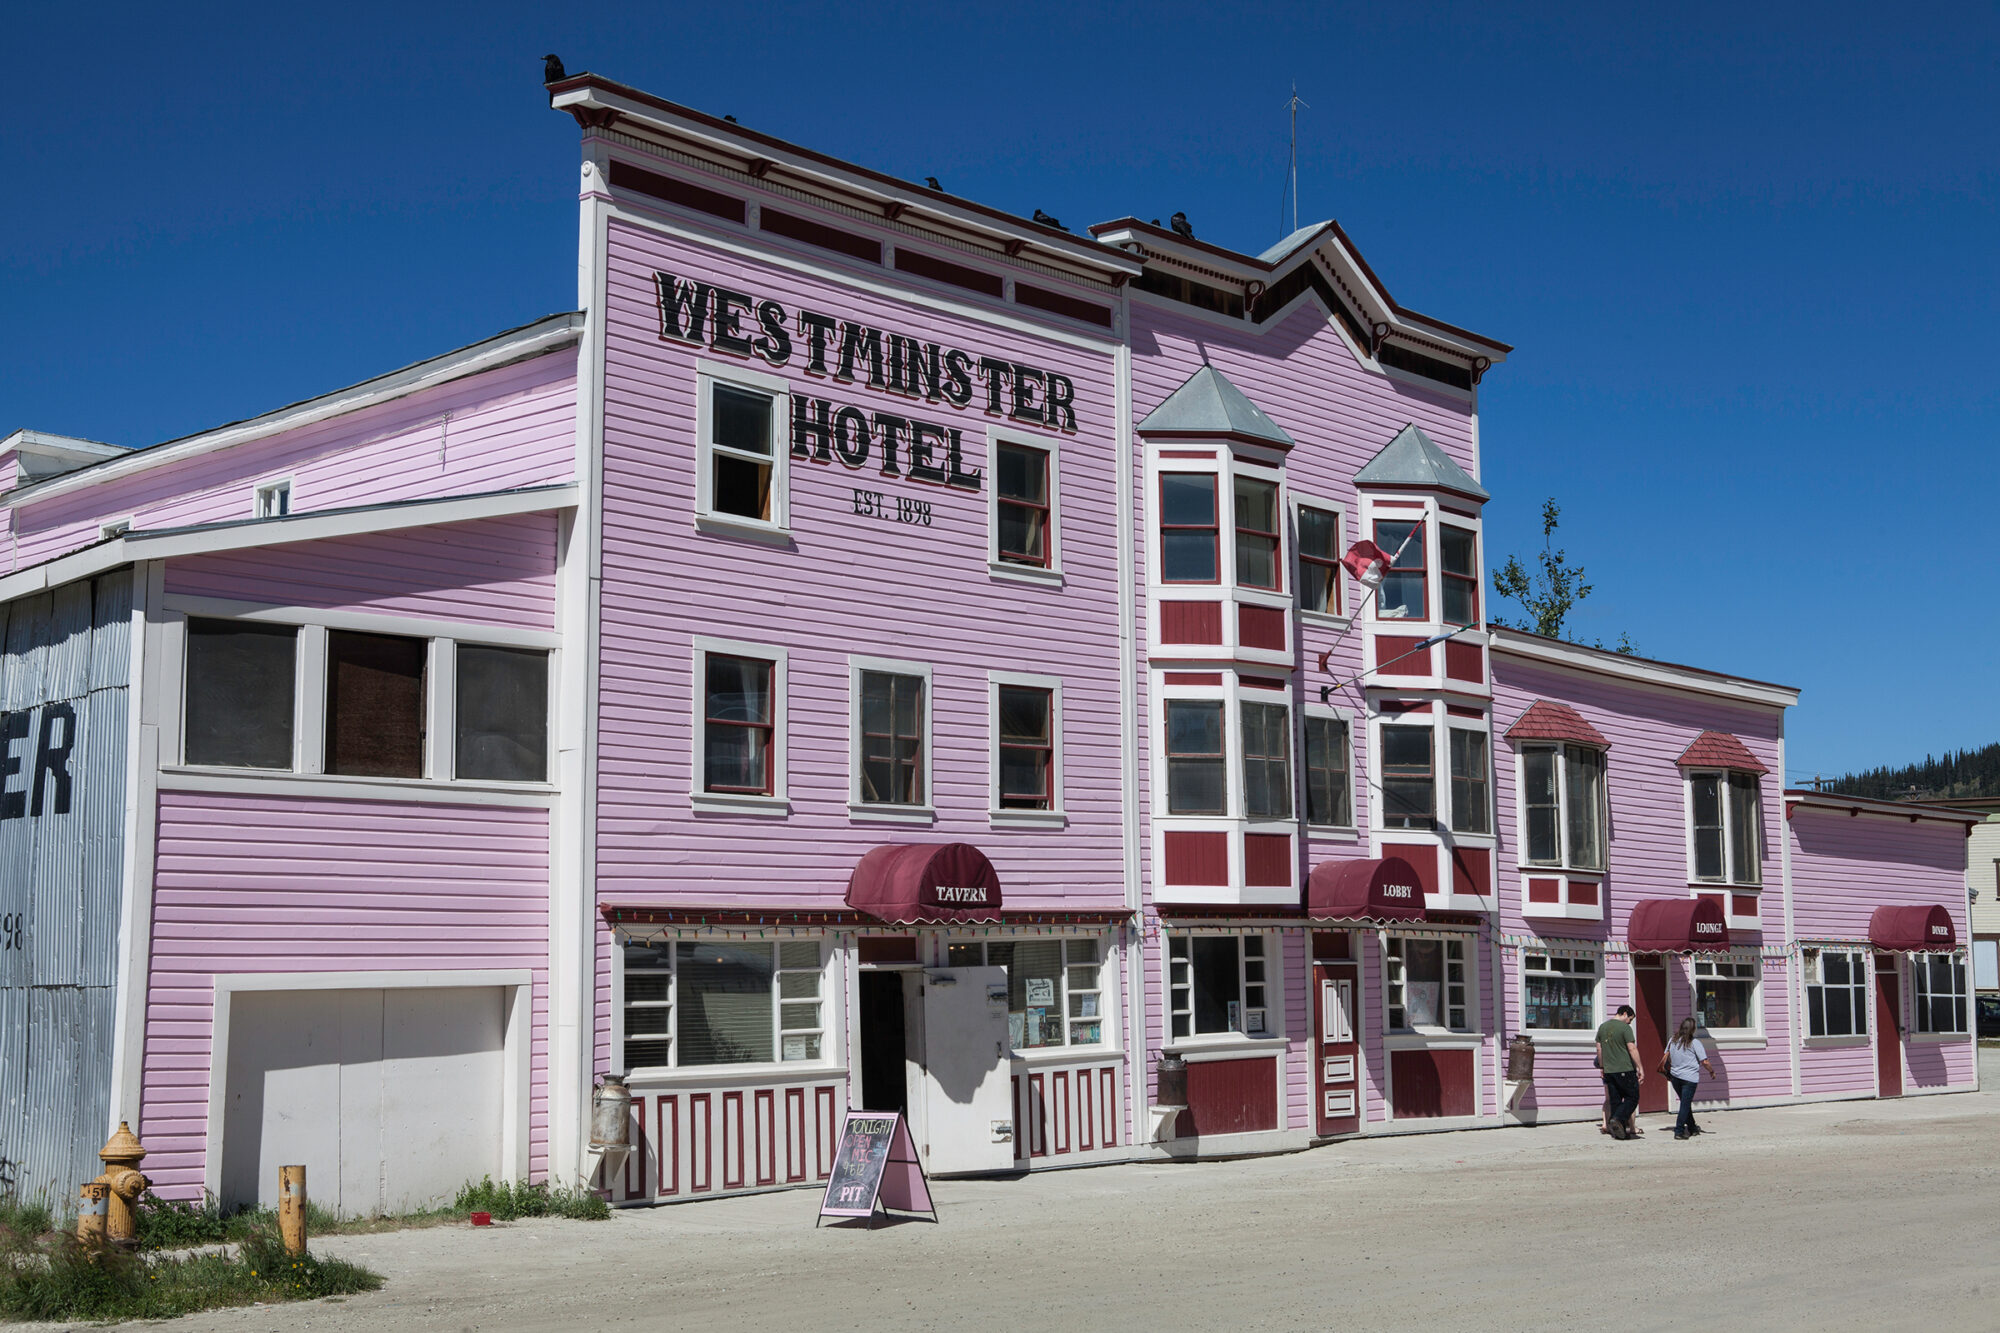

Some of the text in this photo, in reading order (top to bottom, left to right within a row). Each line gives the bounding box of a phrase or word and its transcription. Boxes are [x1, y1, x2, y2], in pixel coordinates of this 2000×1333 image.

[652, 270, 1078, 435] WESTMINSTER
[791, 394, 982, 493] HOTEL
[853, 488, 932, 526] EST. 1898
[935, 885, 987, 902] TAVERN
[1383, 884, 1412, 898] LOBBY
[0, 912, 24, 951] 98
[1696, 922, 1722, 934] LOUNGE
[1931, 925, 1949, 936] DINER
[849, 1119, 893, 1135] TONIGHT
[845, 1134, 872, 1148] OPEN
[851, 1148, 873, 1164] MIC
[839, 1186, 864, 1202] PIT
